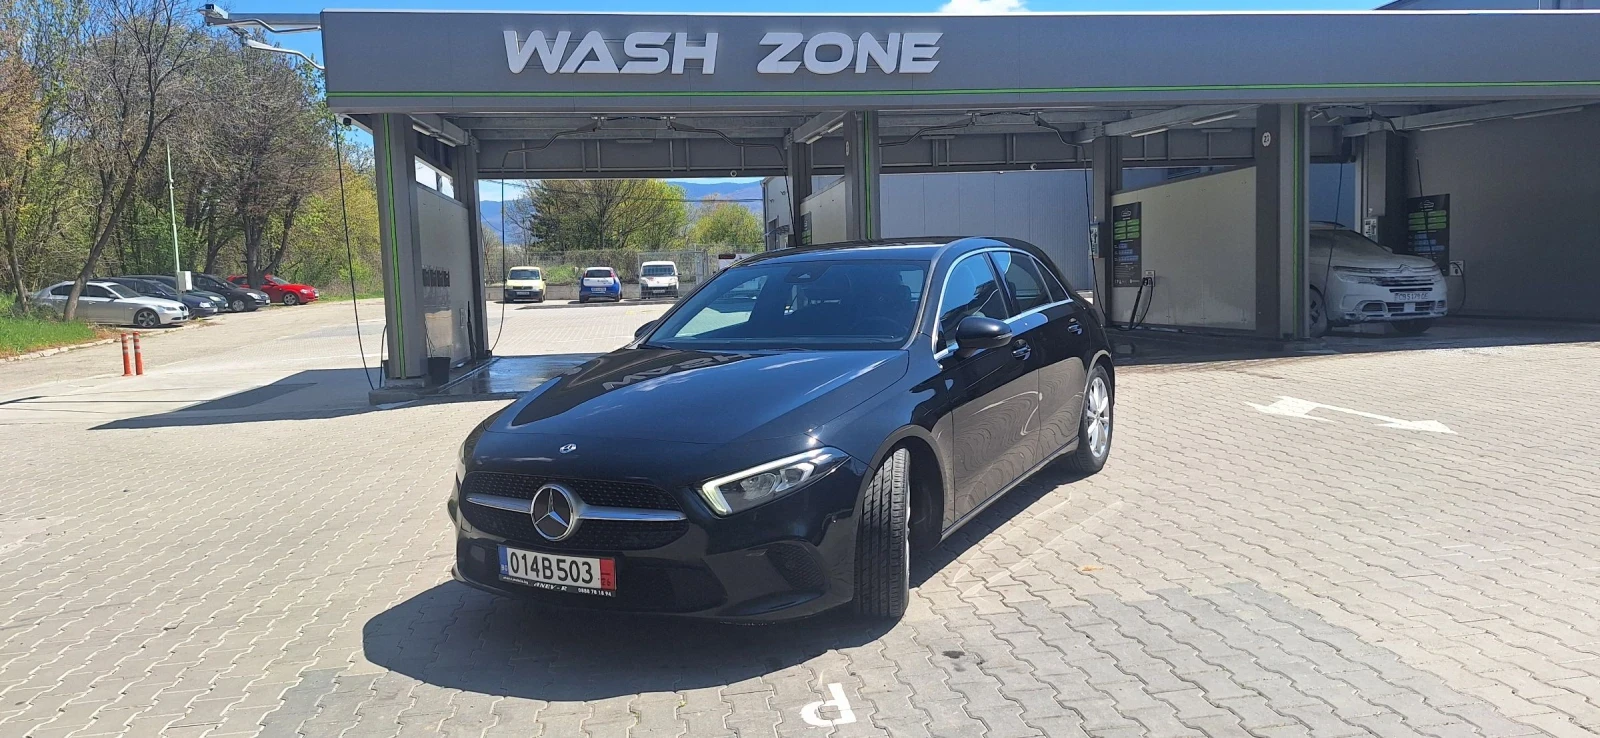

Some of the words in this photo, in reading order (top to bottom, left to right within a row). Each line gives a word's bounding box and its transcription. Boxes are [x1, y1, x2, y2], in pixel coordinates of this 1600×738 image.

[503, 29, 719, 75] WASH
[756, 31, 944, 75] ZONE
[510, 551, 594, 584] 014B503
